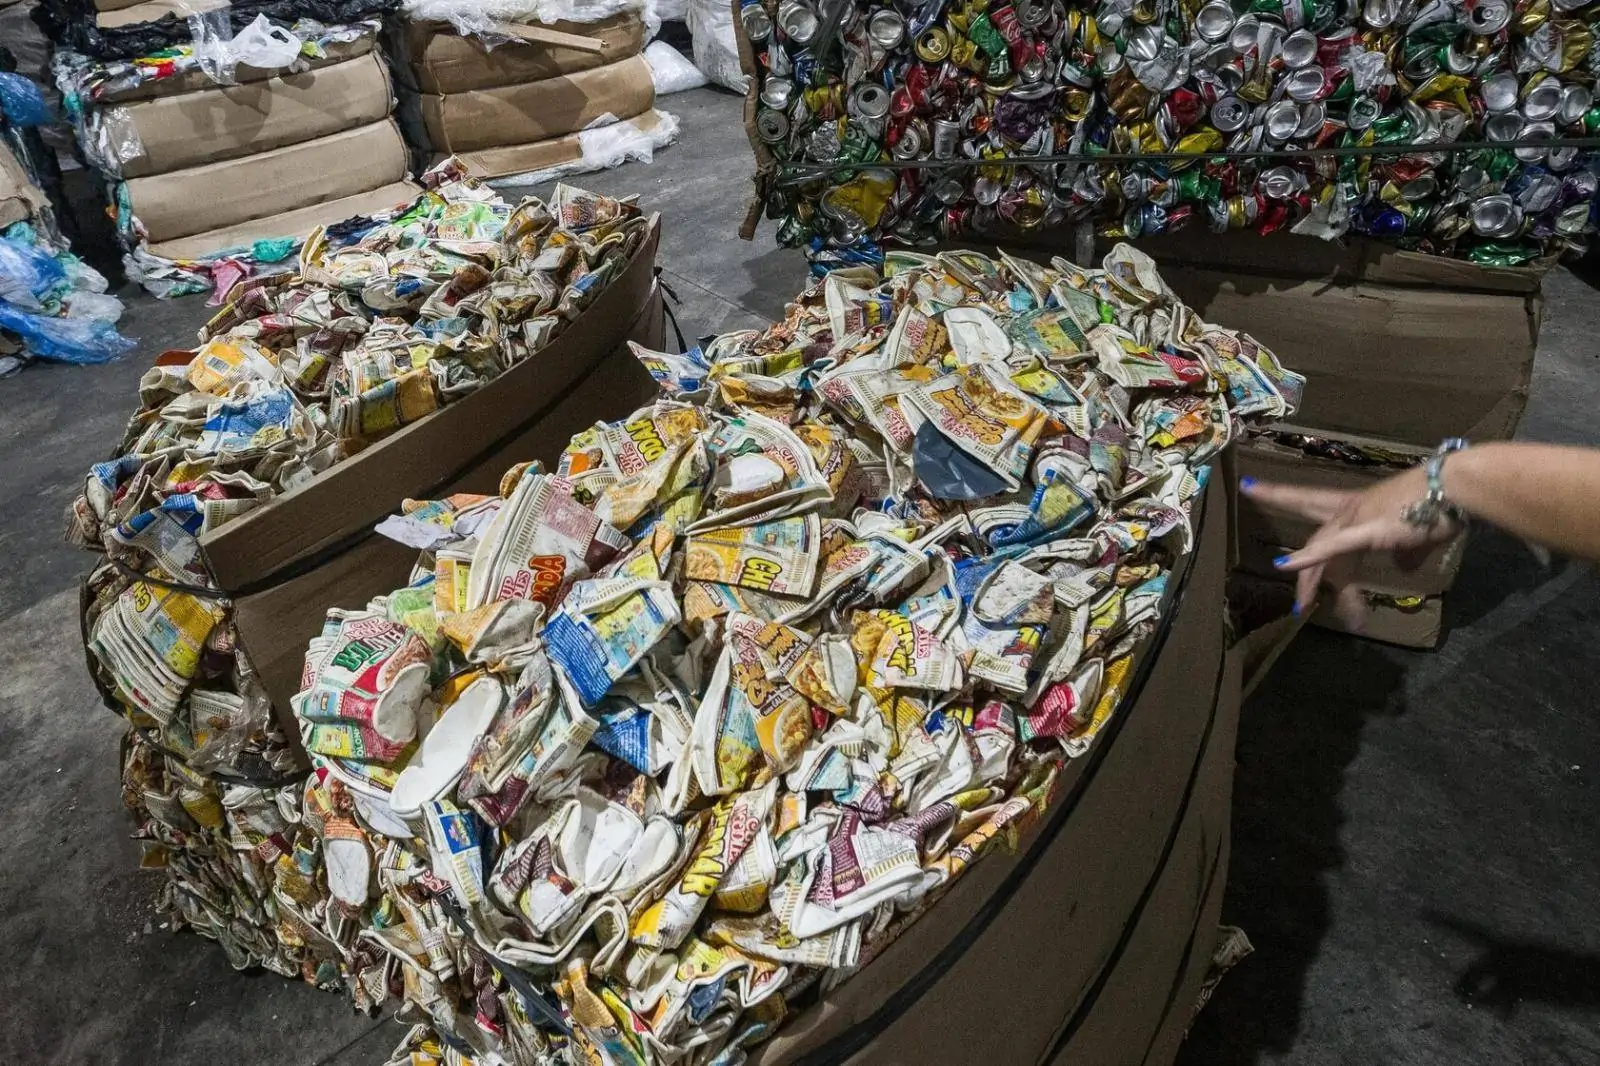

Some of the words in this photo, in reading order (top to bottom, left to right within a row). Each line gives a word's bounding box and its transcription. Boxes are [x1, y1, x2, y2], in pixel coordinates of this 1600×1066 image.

[618, 452, 635, 476] CUP
[623, 441, 643, 470] ODLES
[500, 576, 513, 600] UP
